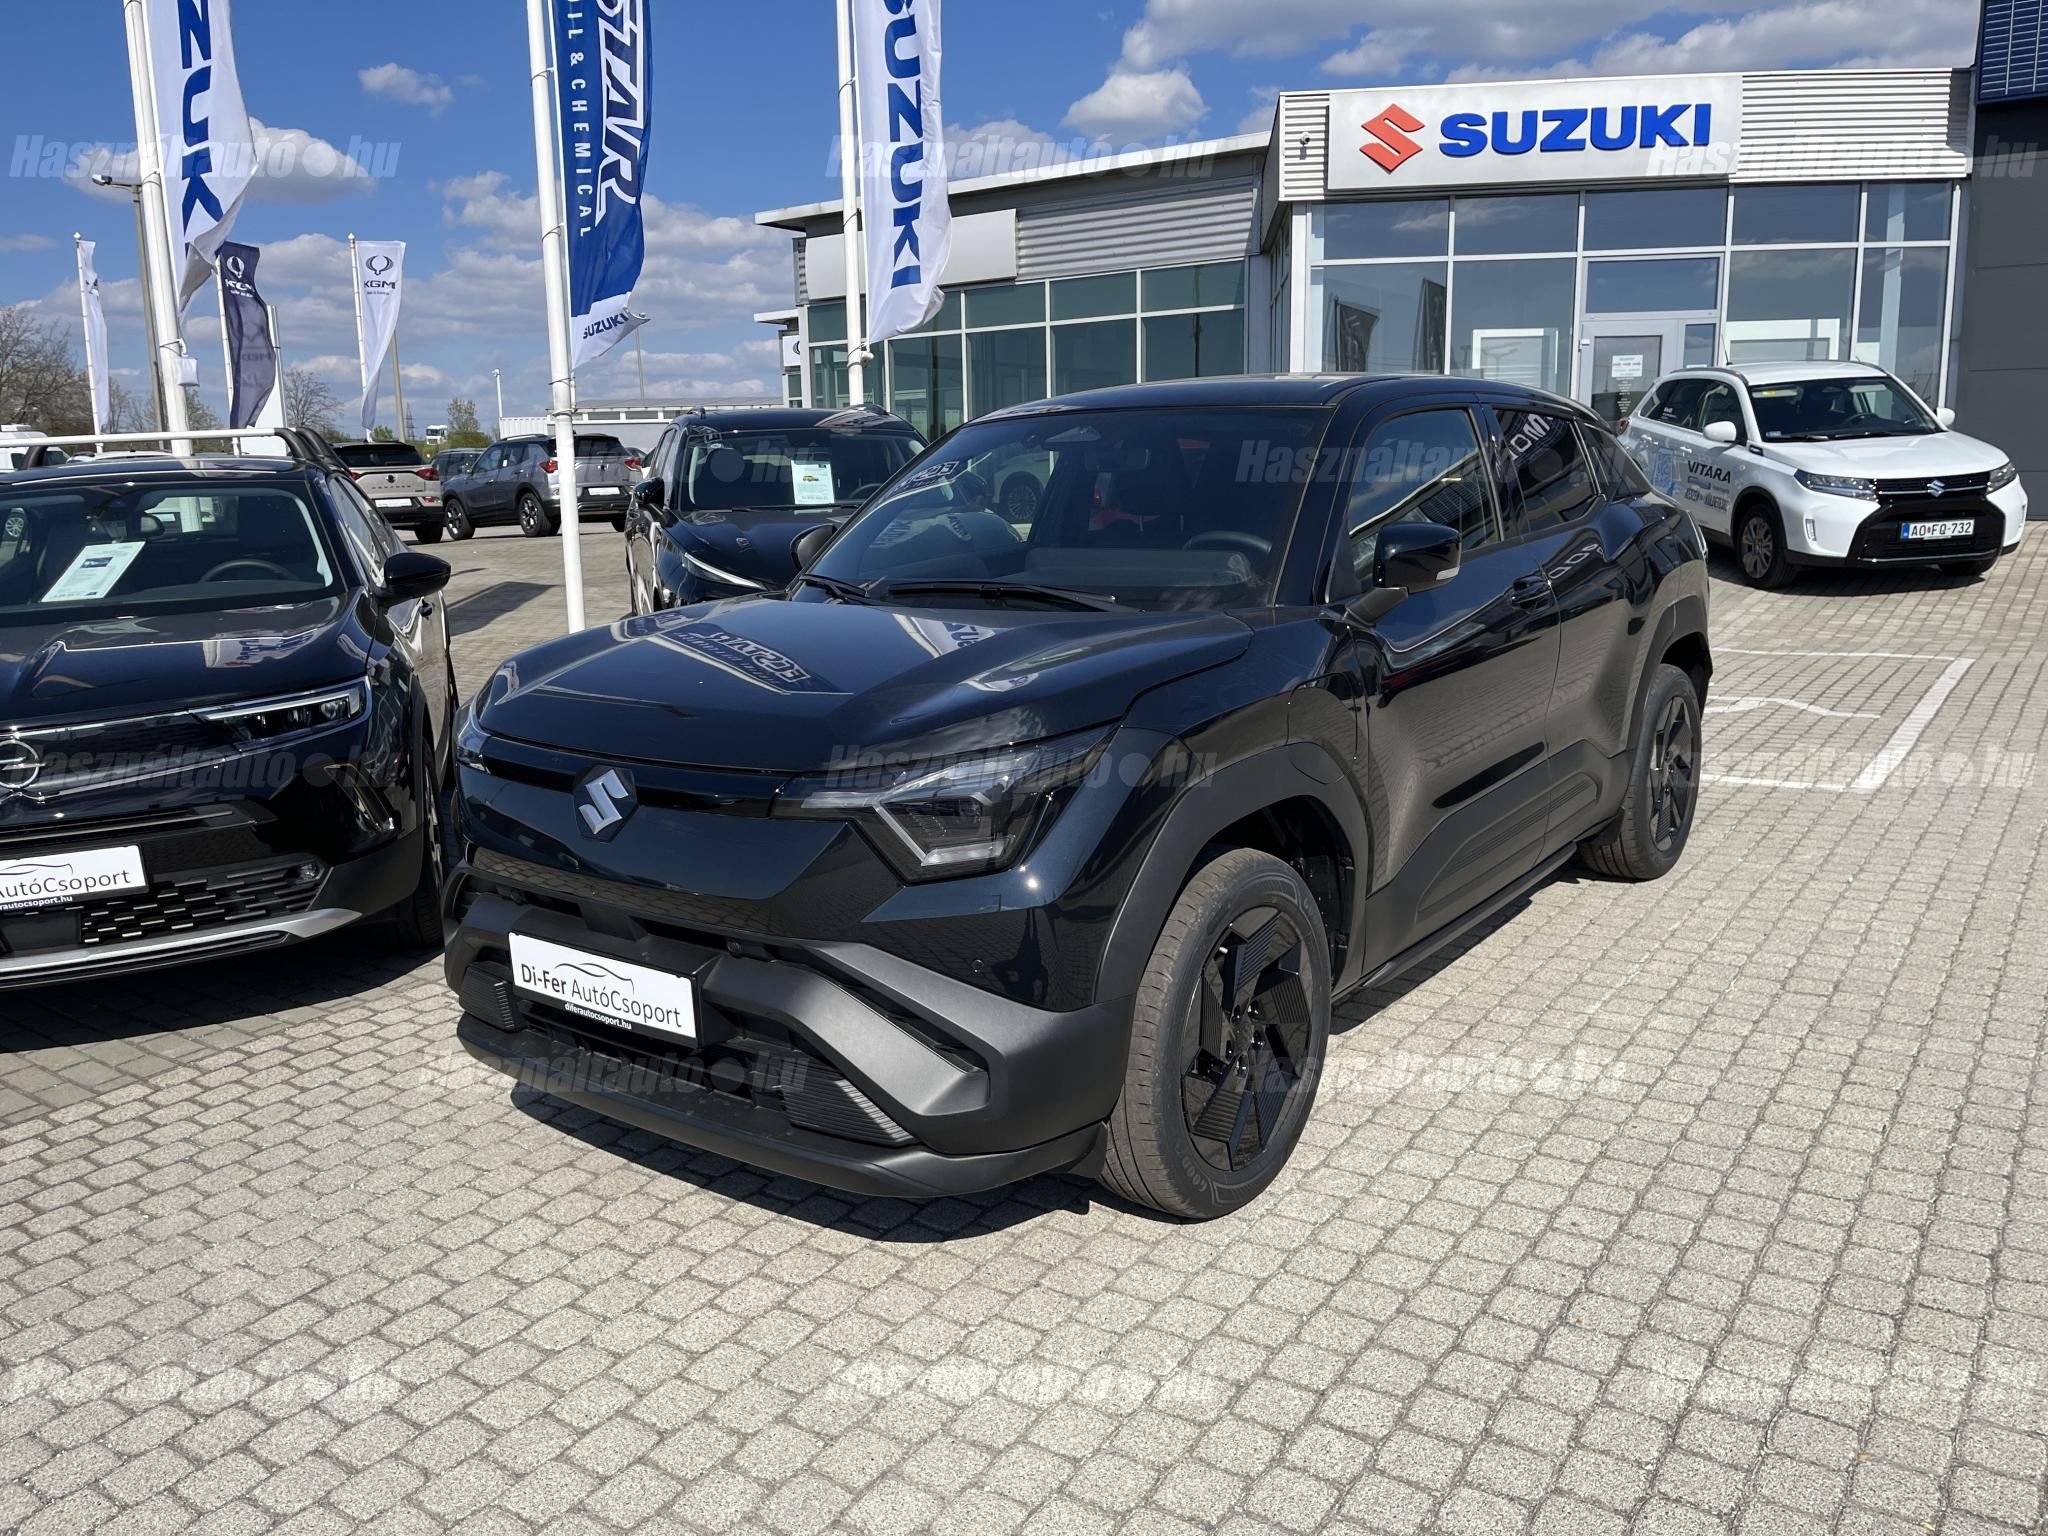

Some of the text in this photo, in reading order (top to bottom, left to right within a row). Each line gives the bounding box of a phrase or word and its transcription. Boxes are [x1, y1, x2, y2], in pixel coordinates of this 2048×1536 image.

[570, 52, 584, 66] &
[884, 0, 922, 289] UZUKI
[1439, 103, 1711, 158] SUZUKI
[571, 78, 594, 238] CHEMICAL
[363, 280, 396, 290] KGM
[583, 313, 630, 339] SUZUKI
[1687, 460, 1731, 484] VITARA
[521, 963, 682, 1028] Di-Fer AutóCsoport
